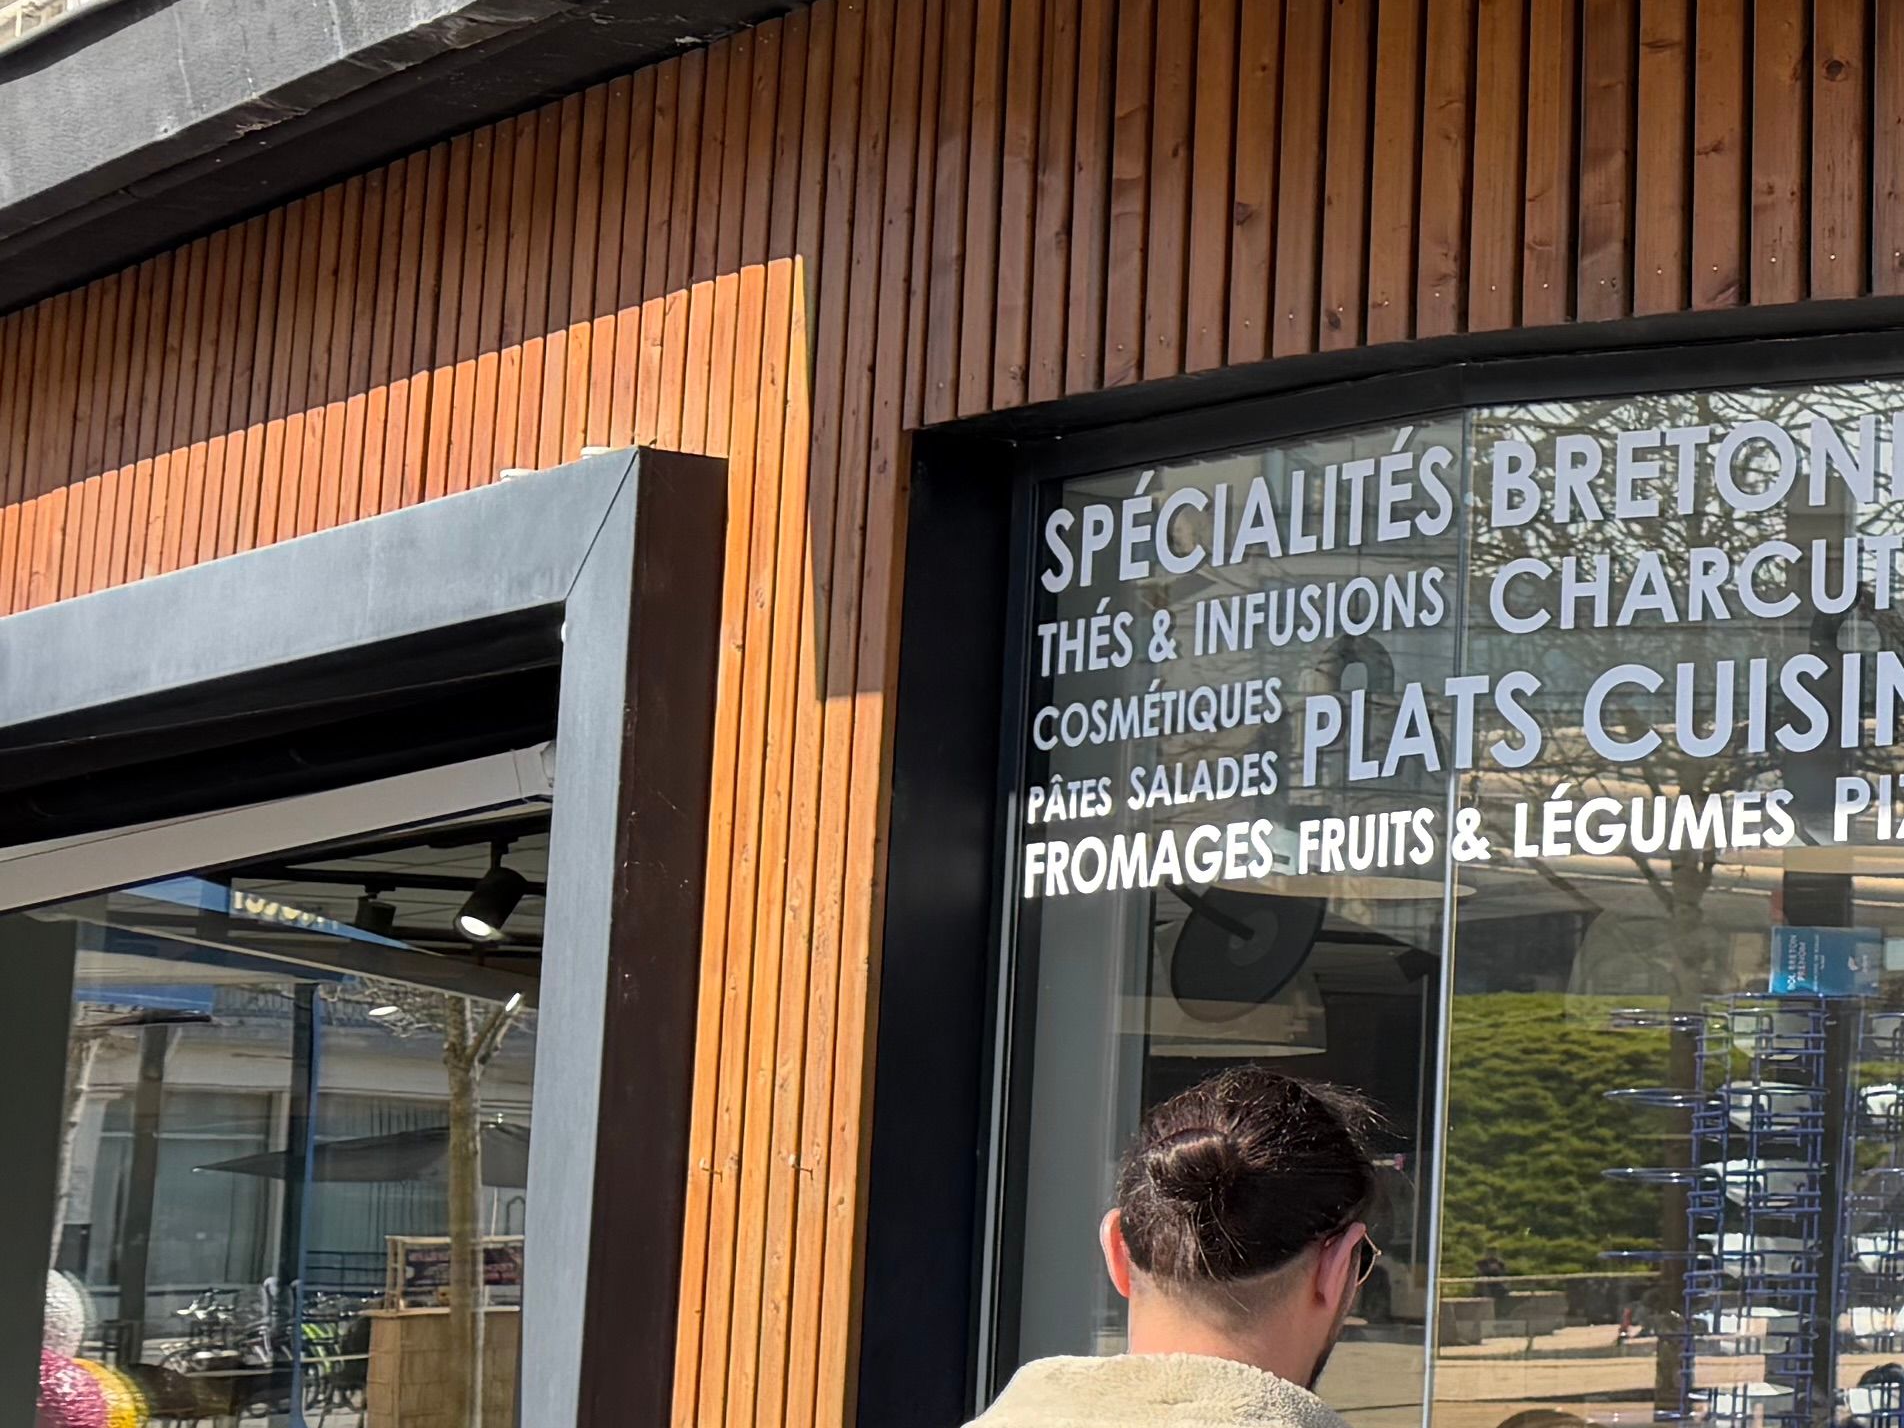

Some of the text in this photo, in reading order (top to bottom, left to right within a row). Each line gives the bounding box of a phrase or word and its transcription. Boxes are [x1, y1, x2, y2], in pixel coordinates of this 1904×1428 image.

[1041, 425, 1457, 594] SPÉCIALITÉS
[1036, 568, 1445, 677] THÉS & INFUSIONS
[1033, 676, 1283, 752] COSMÉTIQUES
[1303, 671, 1542, 788] PLATS
[1023, 817, 1274, 898] FROMAGES
[1298, 806, 1435, 877] FRUITS
[1451, 807, 1490, 860] &
[1514, 785, 1796, 860] LÉGUMES
[1026, 751, 1278, 824] PÂTES SALADES
